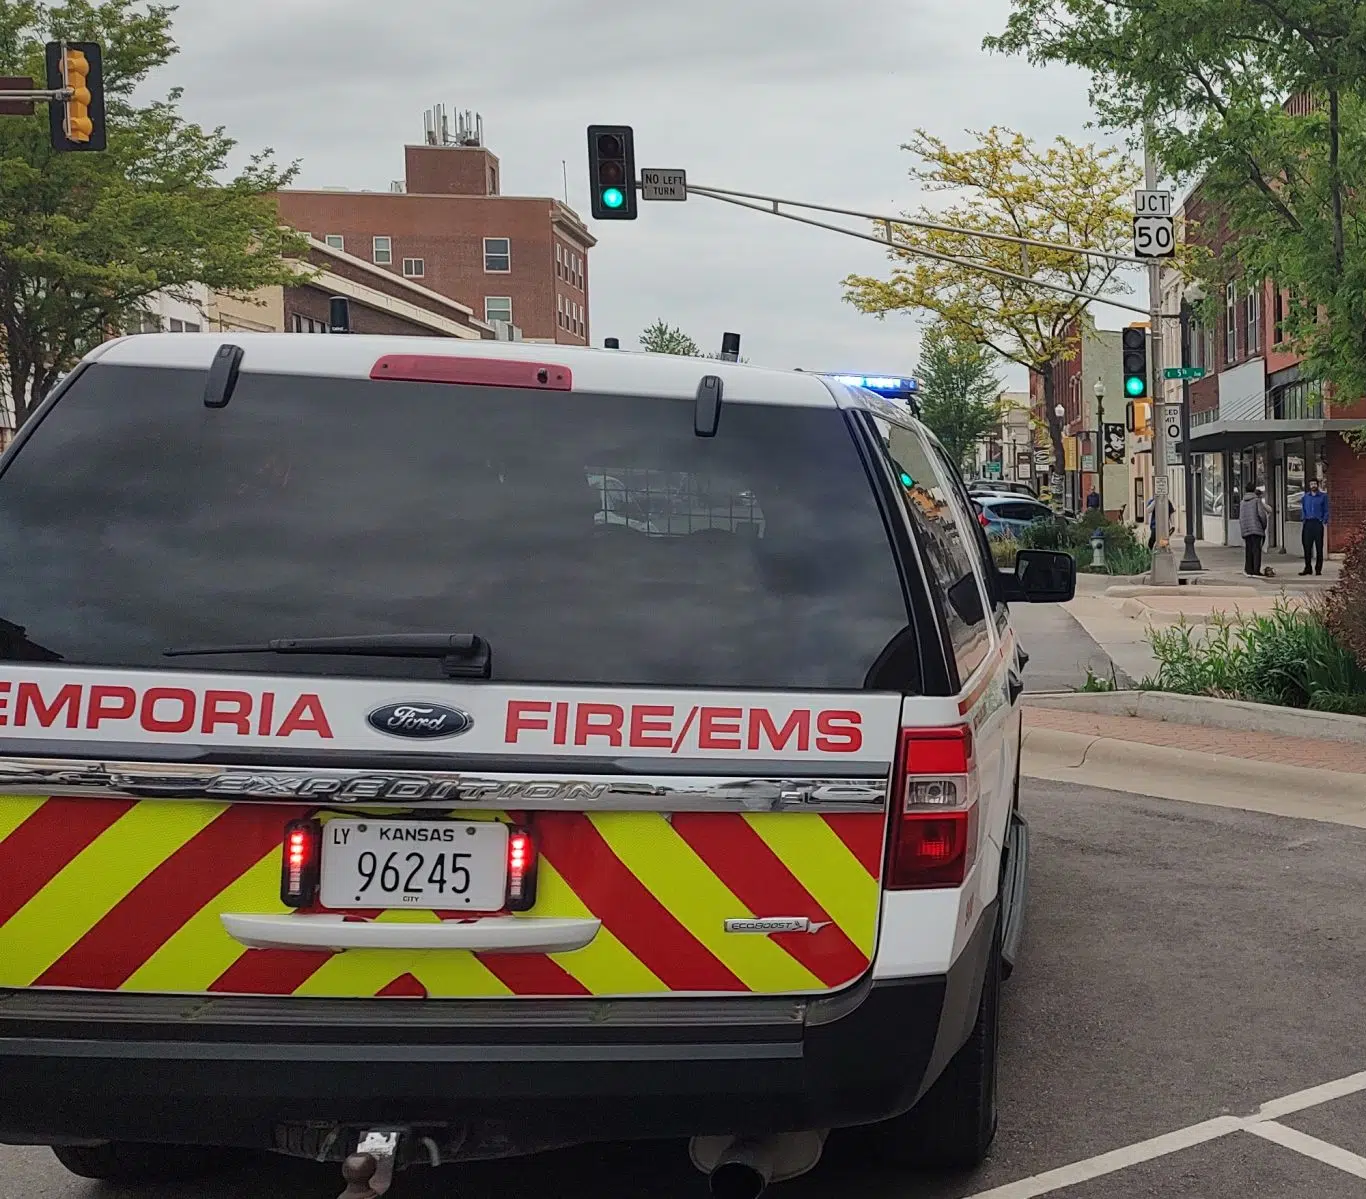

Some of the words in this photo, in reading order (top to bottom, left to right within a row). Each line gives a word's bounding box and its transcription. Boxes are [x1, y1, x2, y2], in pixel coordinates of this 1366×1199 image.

[645, 173, 659, 184] NO
[663, 176, 683, 185] LEFT
[654, 186, 675, 196] TURN
[1137, 194, 1167, 212] JCT
[1138, 226, 1170, 248] 50
[0, 682, 335, 739] MPORIA
[387, 706, 446, 732] Ford
[504, 700, 864, 754] FIRE/EMS
[205, 774, 612, 802] EXPEDITION
[333, 828, 350, 845] LY
[379, 827, 455, 842] KANSAS
[357, 851, 472, 894] 96245
